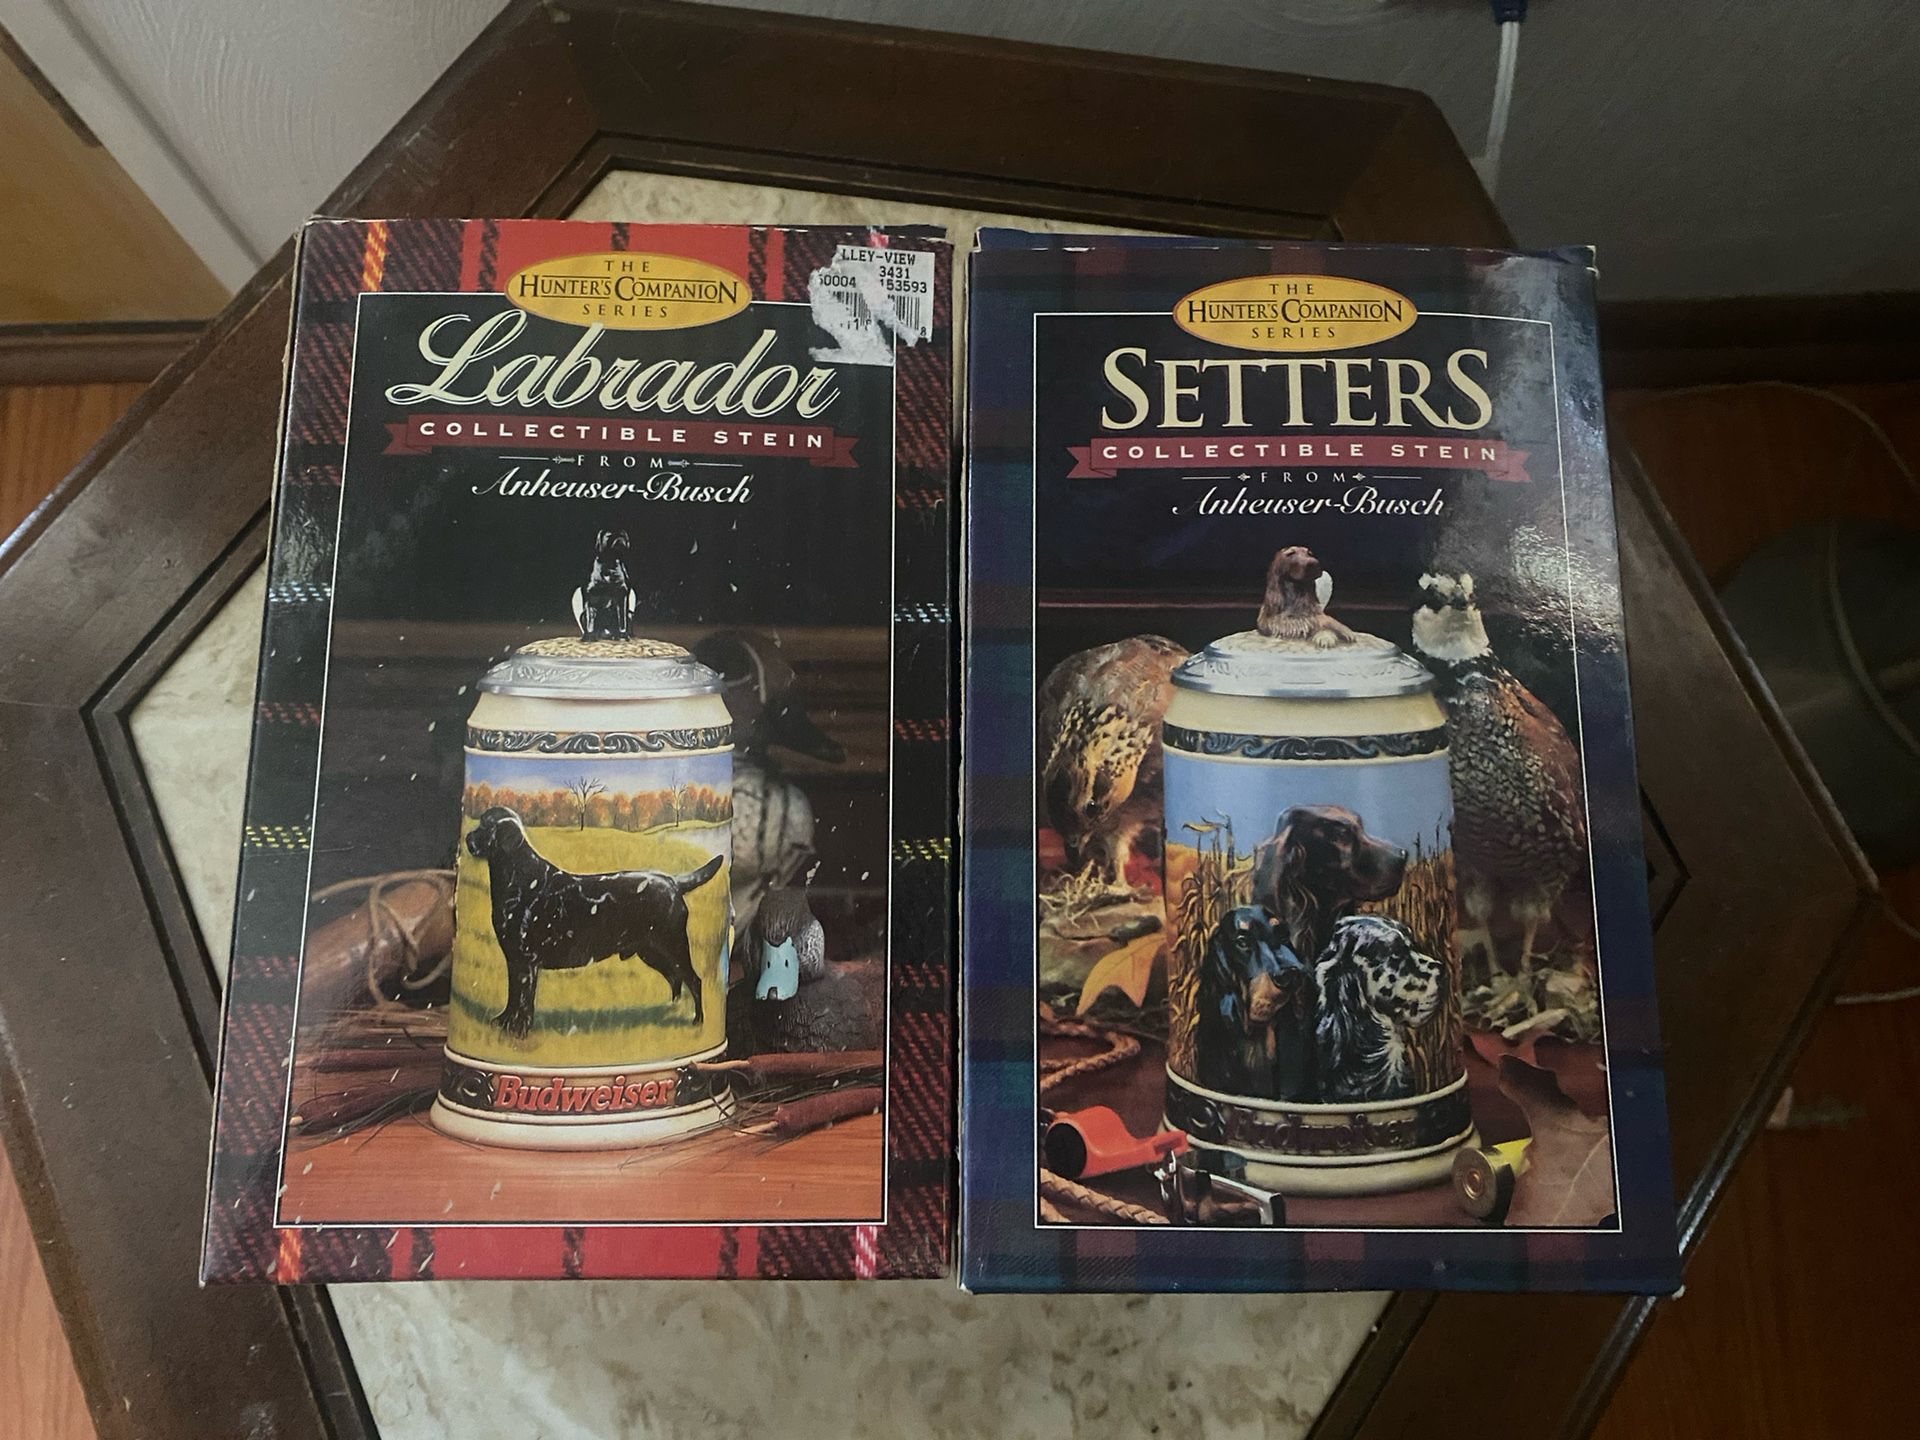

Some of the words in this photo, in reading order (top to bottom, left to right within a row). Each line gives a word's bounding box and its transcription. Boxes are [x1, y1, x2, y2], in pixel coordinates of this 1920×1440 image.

[604, 260, 650, 273] THE
[879, 265, 910, 279] 3431
[519, 274, 611, 298] HUNTER'S
[614, 276, 738, 304] COMPANION
[1269, 283, 1315, 295] THE
[582, 303, 668, 318] SERIES
[1187, 299, 1278, 323] HUNTER'S
[1281, 298, 1402, 324] COMPANION
[1251, 327, 1335, 339] SERIES
[384, 308, 841, 419] Labrador
[1101, 346, 1493, 431] SETTERS
[419, 422, 687, 443] COLLECTIBLE
[713, 430, 822, 448] STEIN
[577, 454, 664, 469] FROM
[1102, 443, 1364, 459] COLLECTIBLE
[1390, 444, 1496, 461] STEIN
[471, 466, 754, 504] Anheuser-Busch
[1260, 471, 1346, 483] FROM
[1171, 485, 1445, 515] Anheuser-Busch
[494, 1075, 675, 1113] Budweiser
